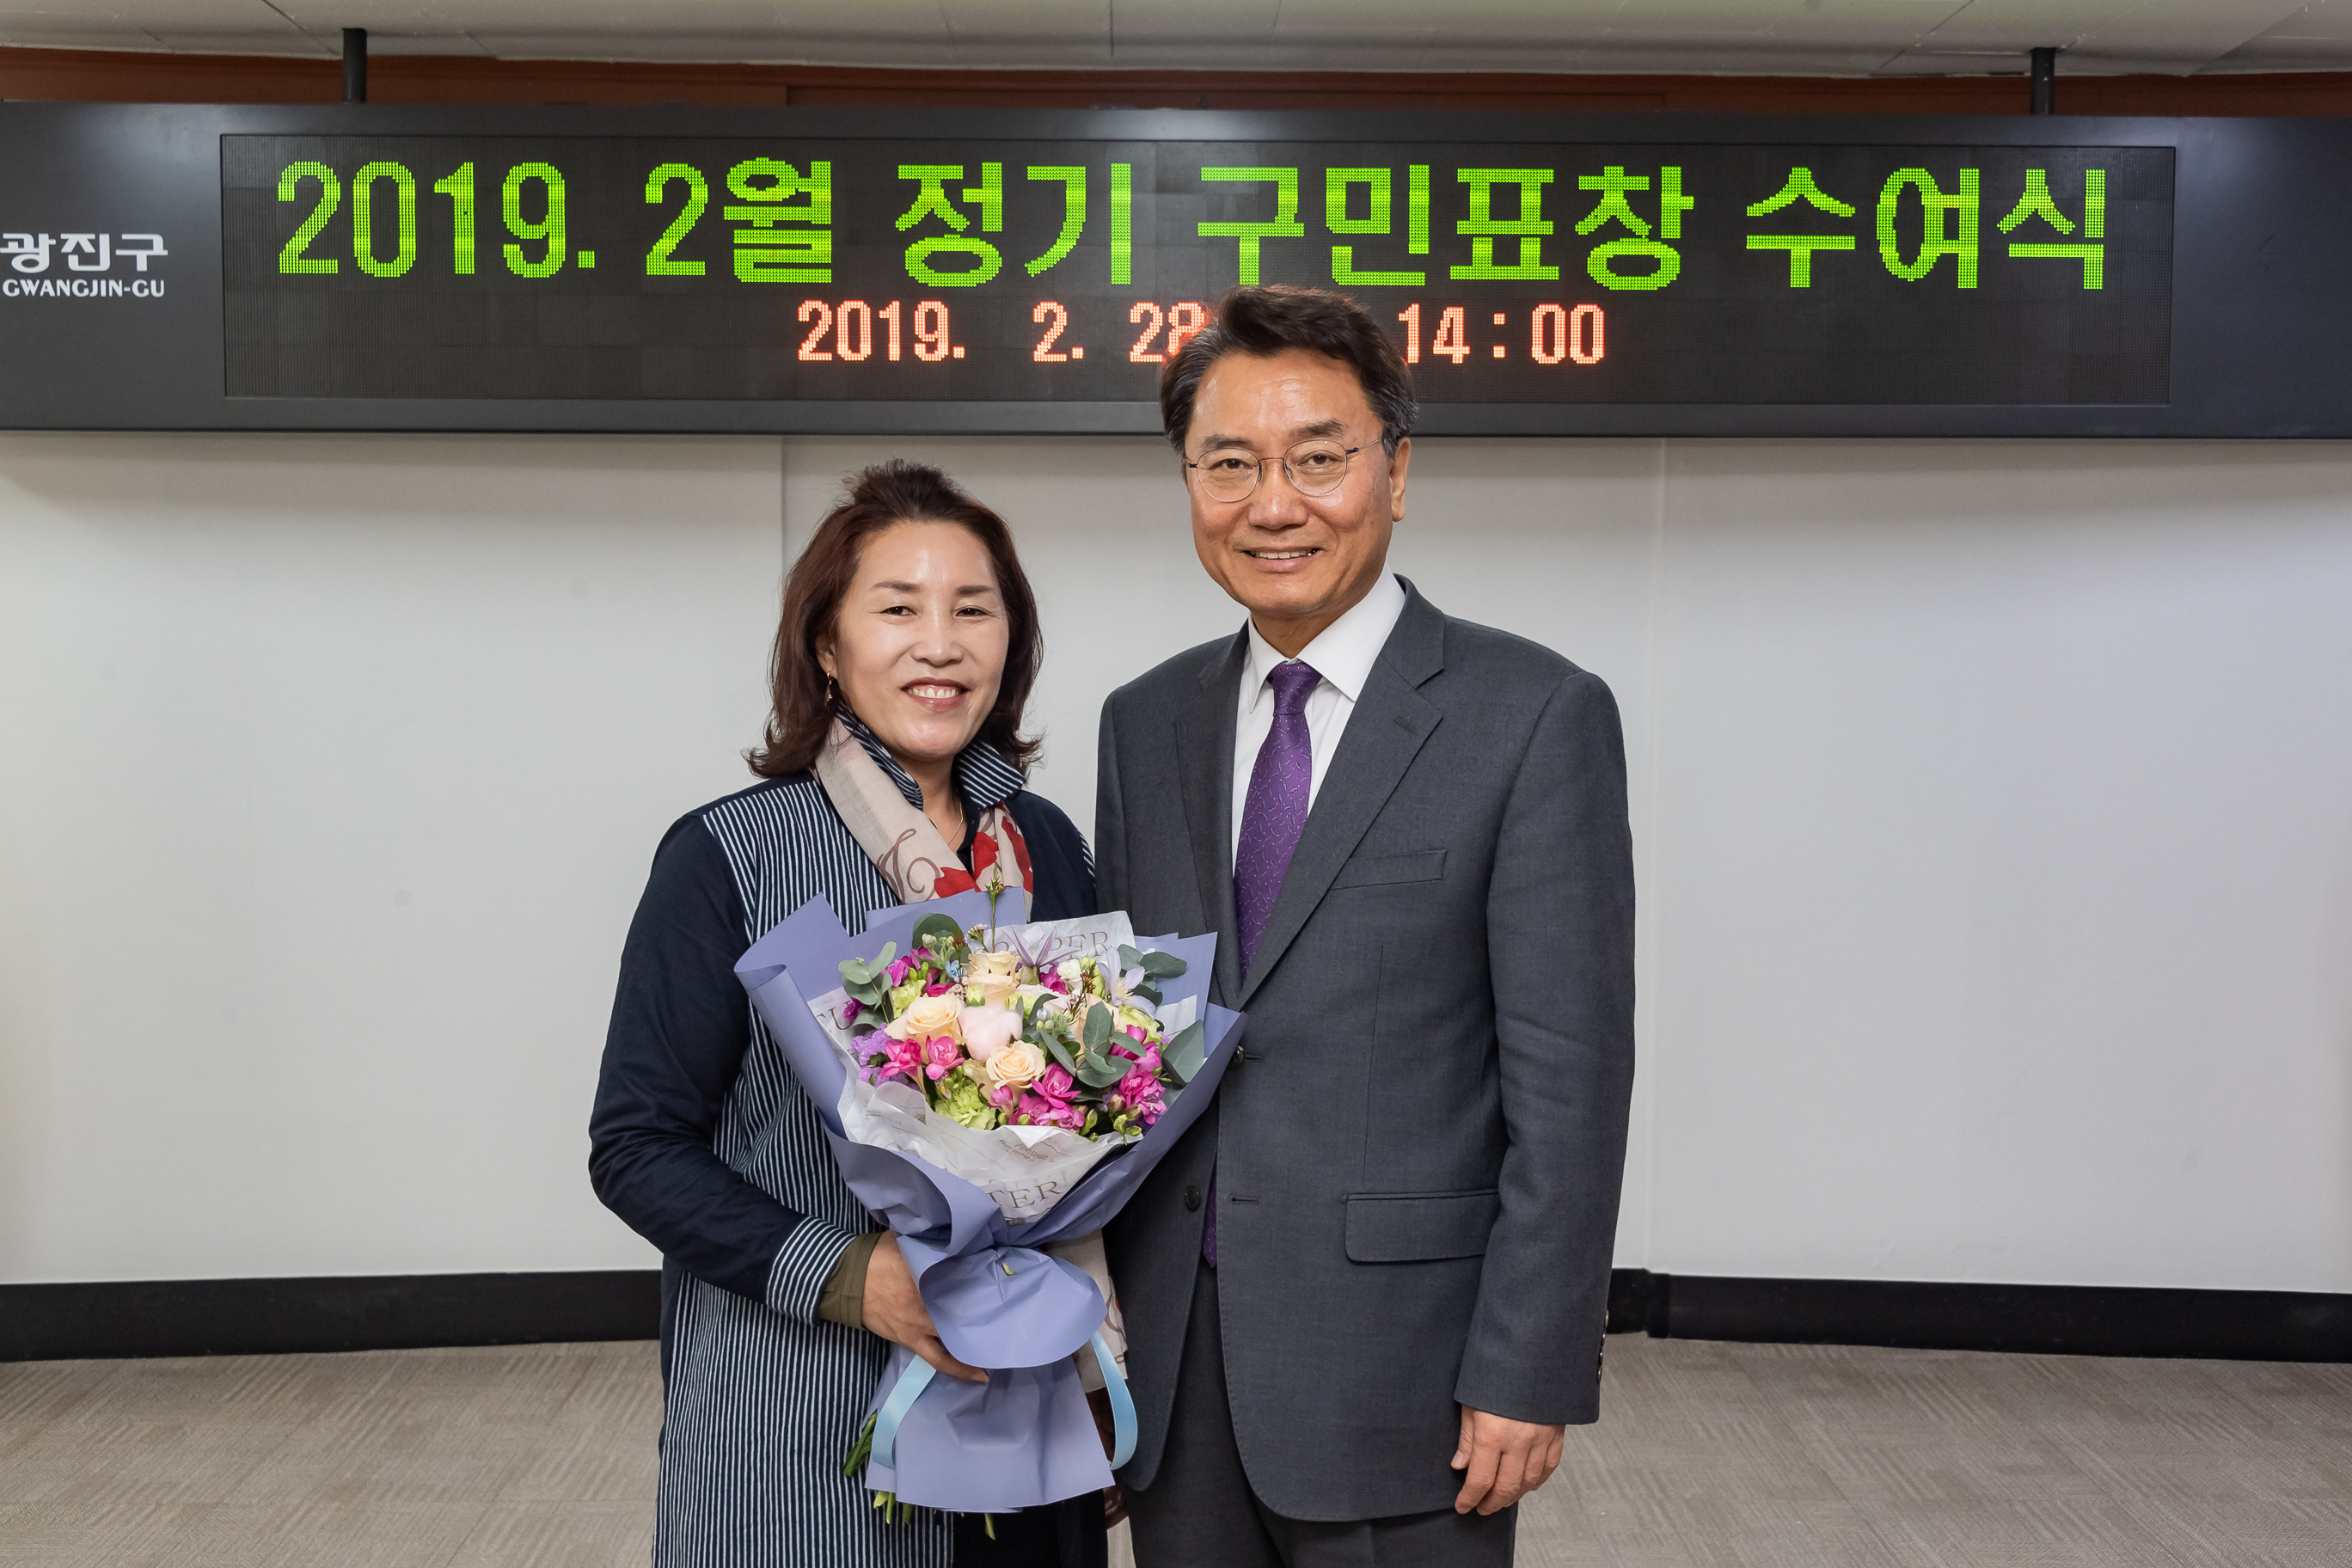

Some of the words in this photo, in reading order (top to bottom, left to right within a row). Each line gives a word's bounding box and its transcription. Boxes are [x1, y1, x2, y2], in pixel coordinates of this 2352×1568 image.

[278, 160, 596, 279] 2019.
[645, 156, 832, 284] 2월
[895, 162, 1132, 287] 정기
[1197, 164, 1694, 291] 구민표창
[1745, 167, 2106, 290] 수여식
[0, 232, 169, 273] 광진구
[2, 279, 166, 298] GWANGJIN-GU
[797, 299, 965, 362] 2019.
[1032, 301, 1084, 363] 2.
